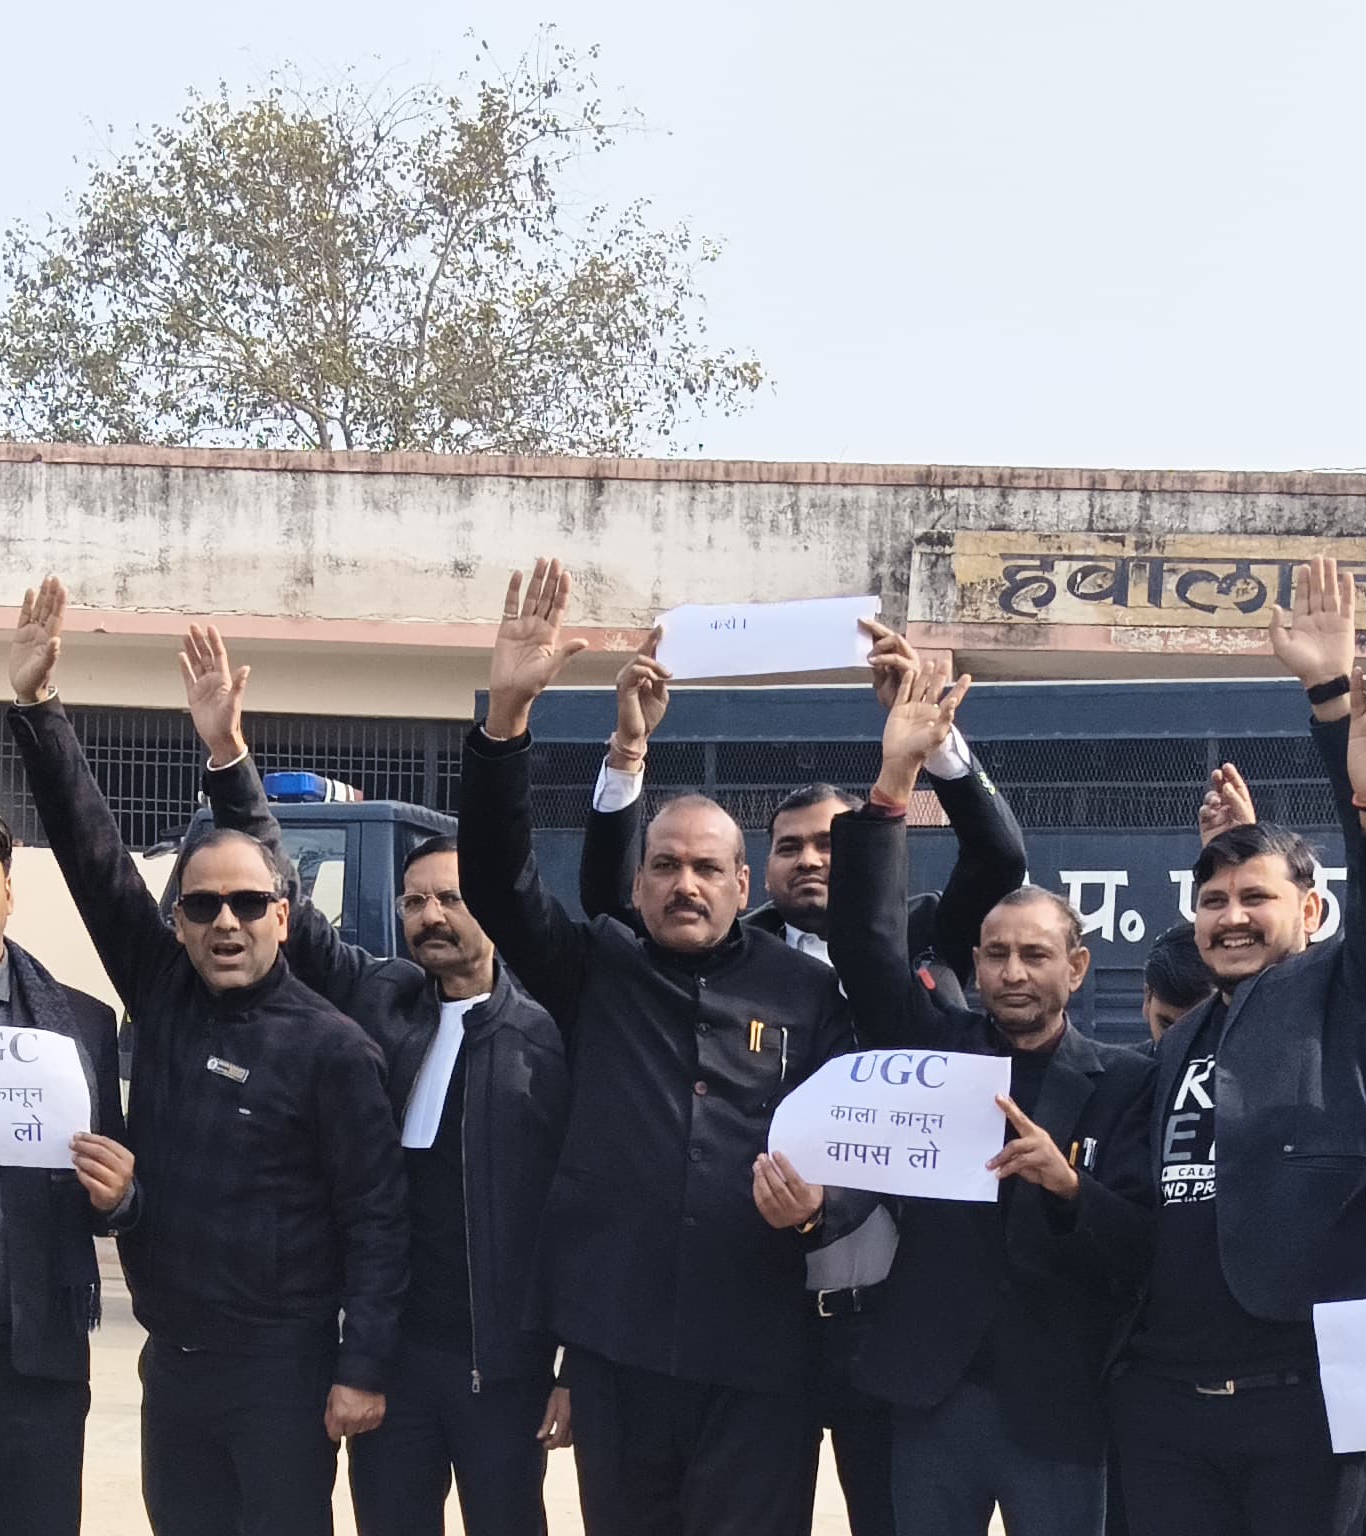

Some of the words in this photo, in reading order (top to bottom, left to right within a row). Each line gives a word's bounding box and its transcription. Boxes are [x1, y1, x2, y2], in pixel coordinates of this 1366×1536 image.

[850, 1053, 949, 1089] UGC
[10, 1114, 44, 1142] लो
[830, 1104, 879, 1124] काला
[889, 1110, 945, 1134] कानून
[825, 1140, 892, 1167] वापस
[906, 1140, 941, 1169] लो
